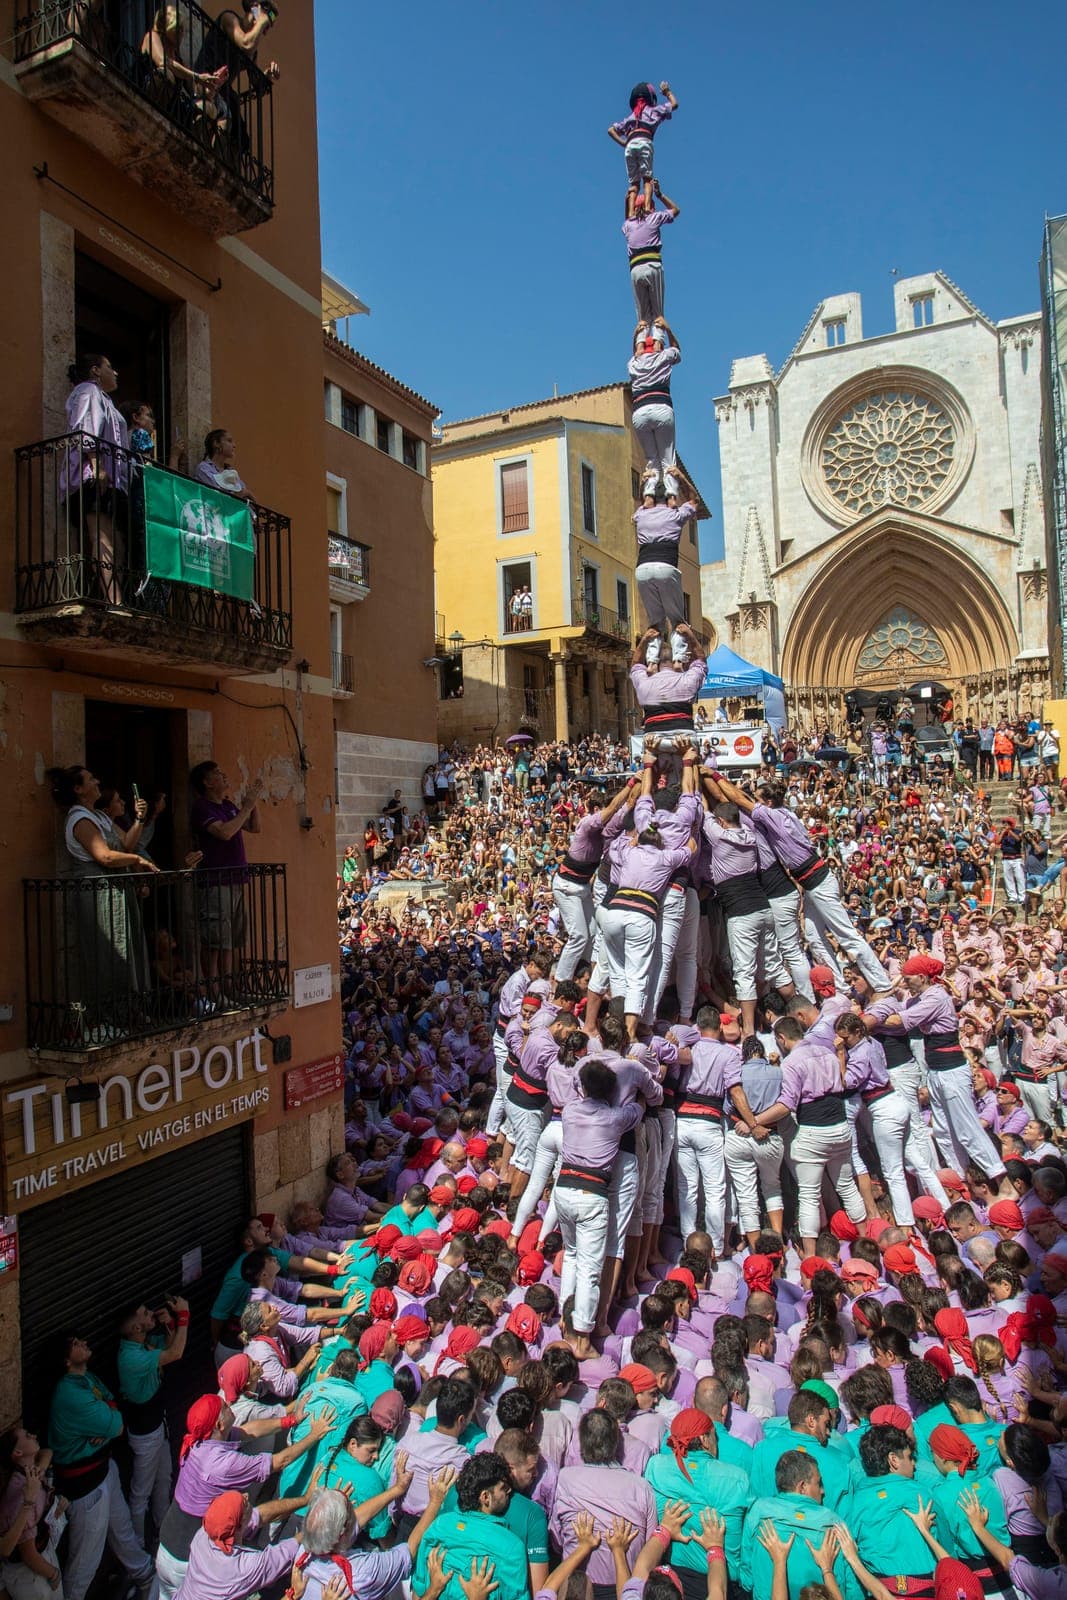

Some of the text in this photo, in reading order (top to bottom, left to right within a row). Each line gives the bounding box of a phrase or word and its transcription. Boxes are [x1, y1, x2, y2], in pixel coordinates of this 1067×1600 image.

[303, 988, 324, 1000] MAJOR
[12, 1165, 58, 1200] TIME
[62, 1141, 128, 1180] TRAVEL
[136, 1116, 192, 1150] VIATGE
[194, 1111, 213, 1129] EN
[214, 1102, 230, 1121] EL
[231, 1086, 270, 1115] TEMPS
